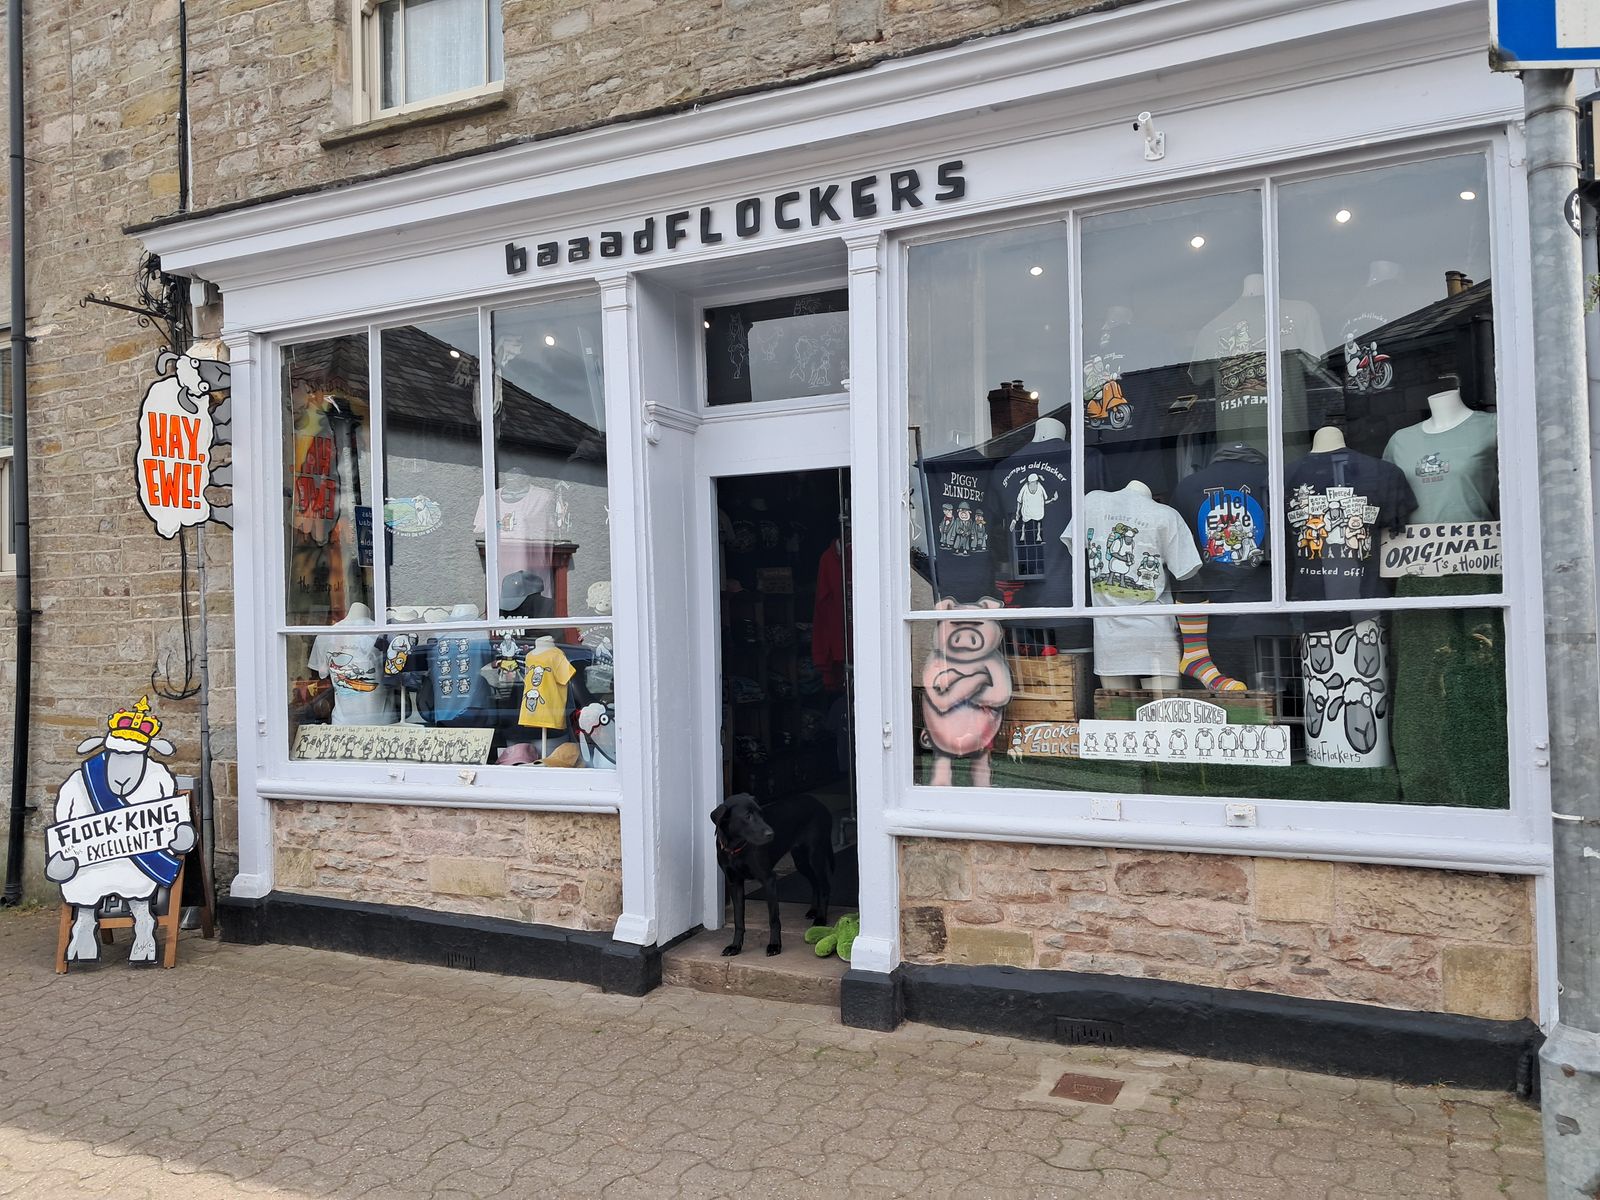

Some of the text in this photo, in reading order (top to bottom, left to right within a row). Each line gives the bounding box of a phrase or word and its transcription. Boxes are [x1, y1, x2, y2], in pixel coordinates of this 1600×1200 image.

[147, 411, 206, 464] HAY,
[1028, 461, 1041, 469] old
[143, 459, 203, 509] EWE!
[951, 472, 978, 488] PIGGY
[942, 483, 984, 502] BLINDERS
[1390, 523, 1501, 540] LOCKER
[1385, 539, 1498, 569] ORIGINAL
[1452, 562, 1459, 572] &
[1459, 553, 1502, 572] HOODIE
[1344, 567, 1365, 576] off!
[1138, 700, 1224, 724] FLOCKERS SIZES
[1030, 741, 1080, 755] SOCKS
[55, 804, 179, 847] FLOCK-KING
